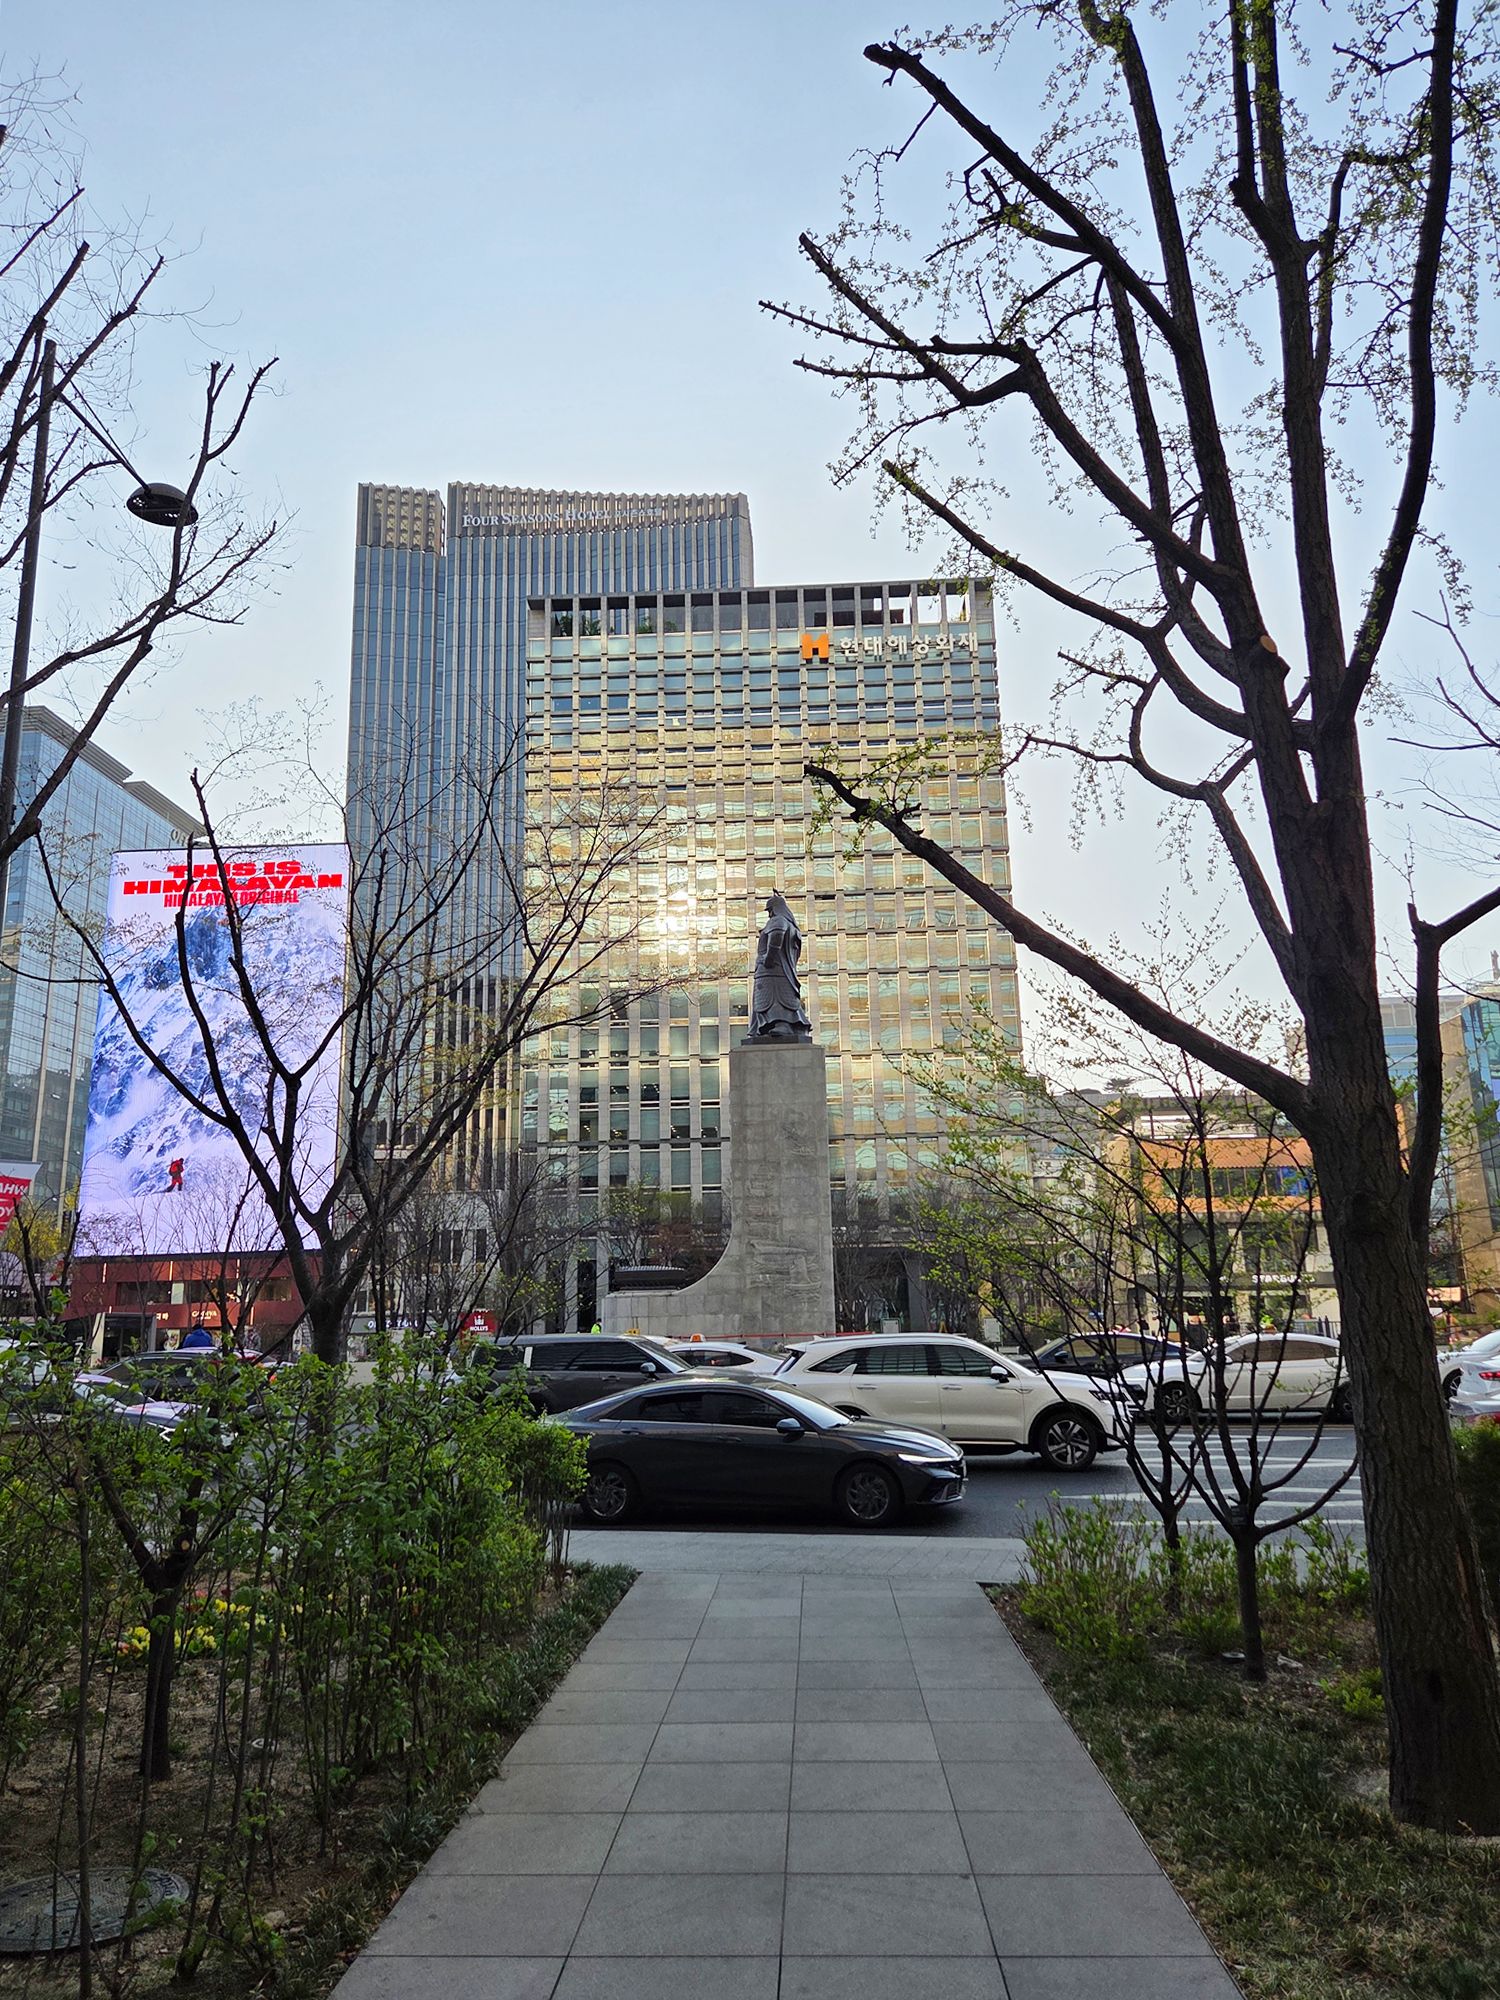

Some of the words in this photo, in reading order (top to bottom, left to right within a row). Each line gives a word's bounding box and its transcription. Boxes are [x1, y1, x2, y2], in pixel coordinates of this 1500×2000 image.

[462, 513, 500, 528] FOUR
[501, 511, 561, 525] SEASONS
[565, 508, 613, 521] HOTEL
[839, 631, 978, 657] 현대해상화재
[166, 863, 257, 879] THIS
[263, 860, 301, 876] IS
[122, 873, 343, 895] HIMALAYAN
[1251, 1274, 1316, 1284] STARBU
